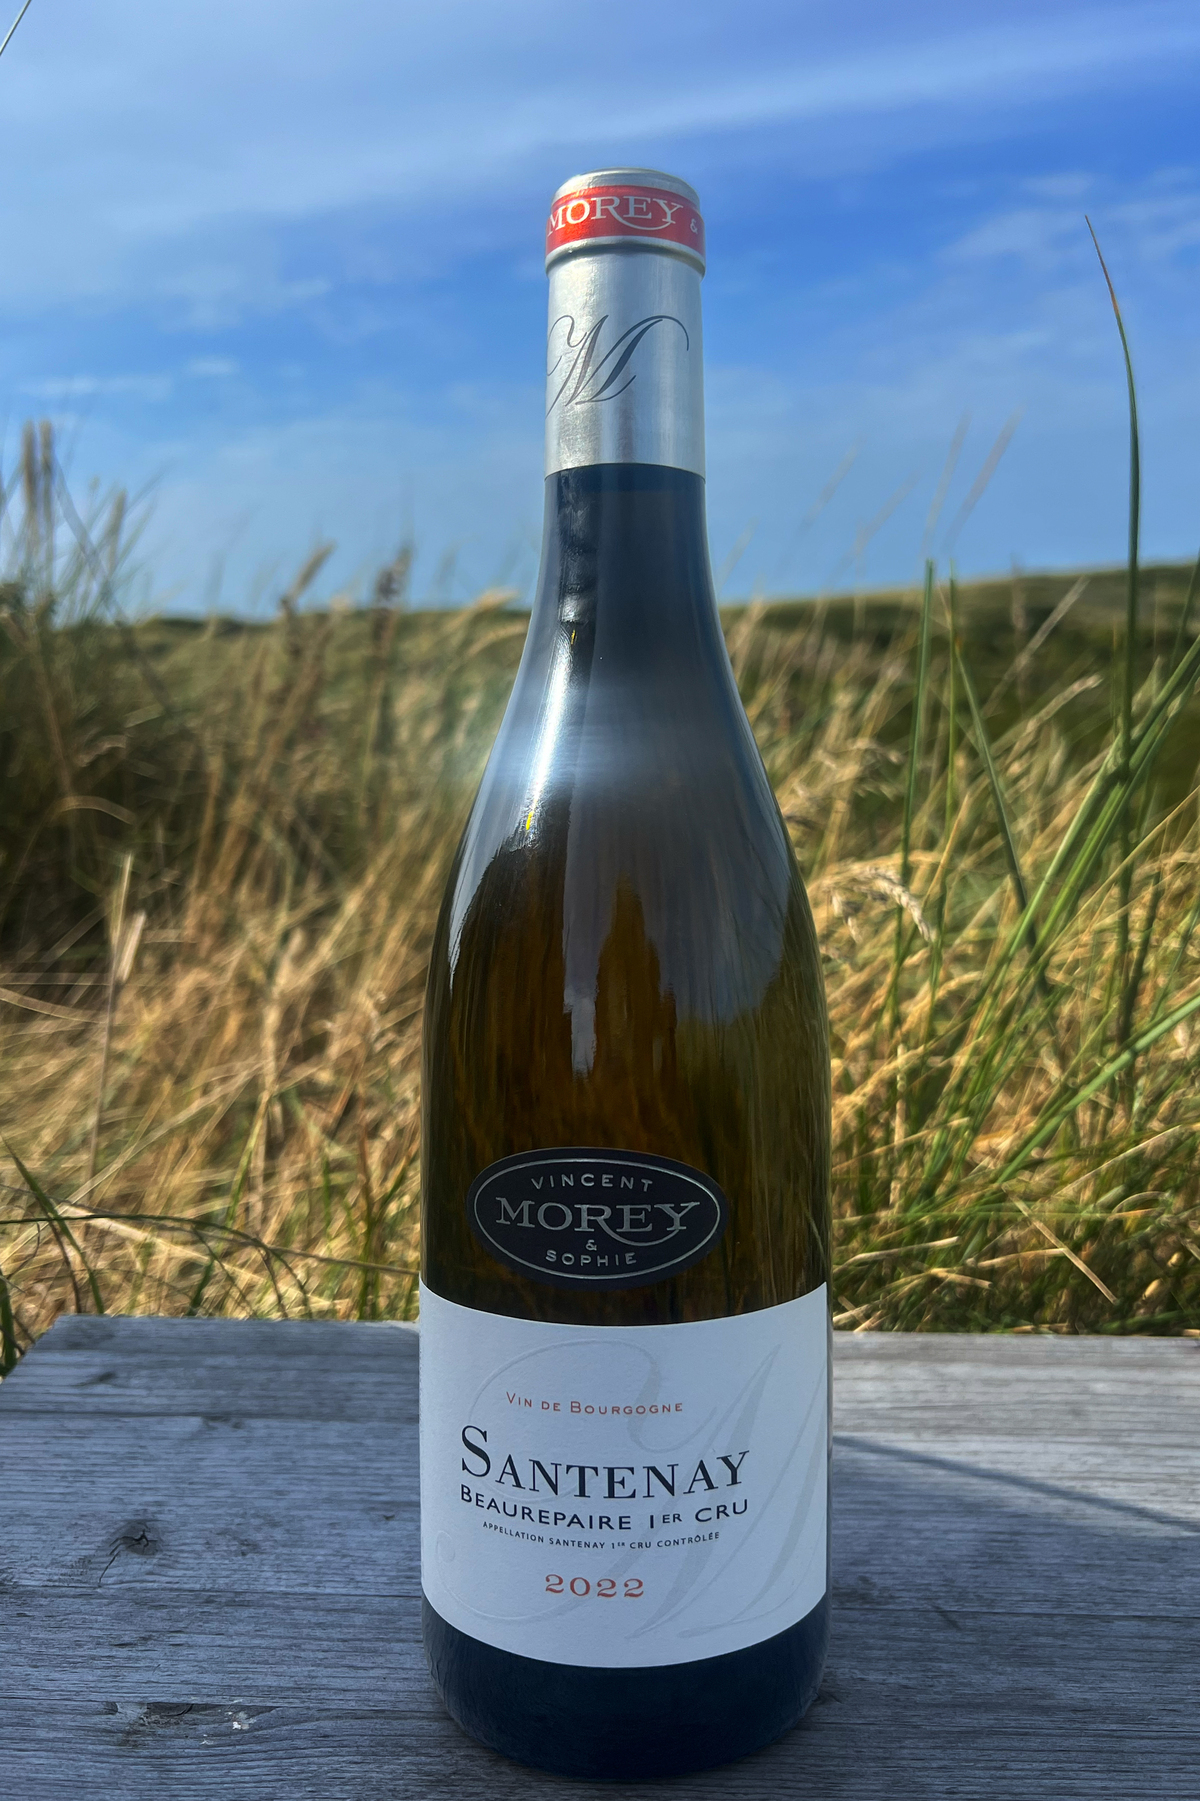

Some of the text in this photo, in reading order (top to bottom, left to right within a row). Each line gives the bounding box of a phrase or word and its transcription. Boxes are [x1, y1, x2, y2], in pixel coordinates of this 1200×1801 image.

[547, 196, 683, 237] MOREY
[531, 1173, 653, 1192] VINCENT
[495, 1196, 700, 1247] MOREY
[585, 1239, 598, 1251] &
[545, 1250, 637, 1267] SOPHIE
[695, 1499, 748, 1523] CRU
[483, 1521, 544, 1543] APPELLATION
[549, 1537, 605, 1550] SANTENAY
[629, 1541, 652, 1549] CRU
[656, 1531, 720, 1548] CONTRÔLÉE
[545, 1574, 645, 1598] 2022
